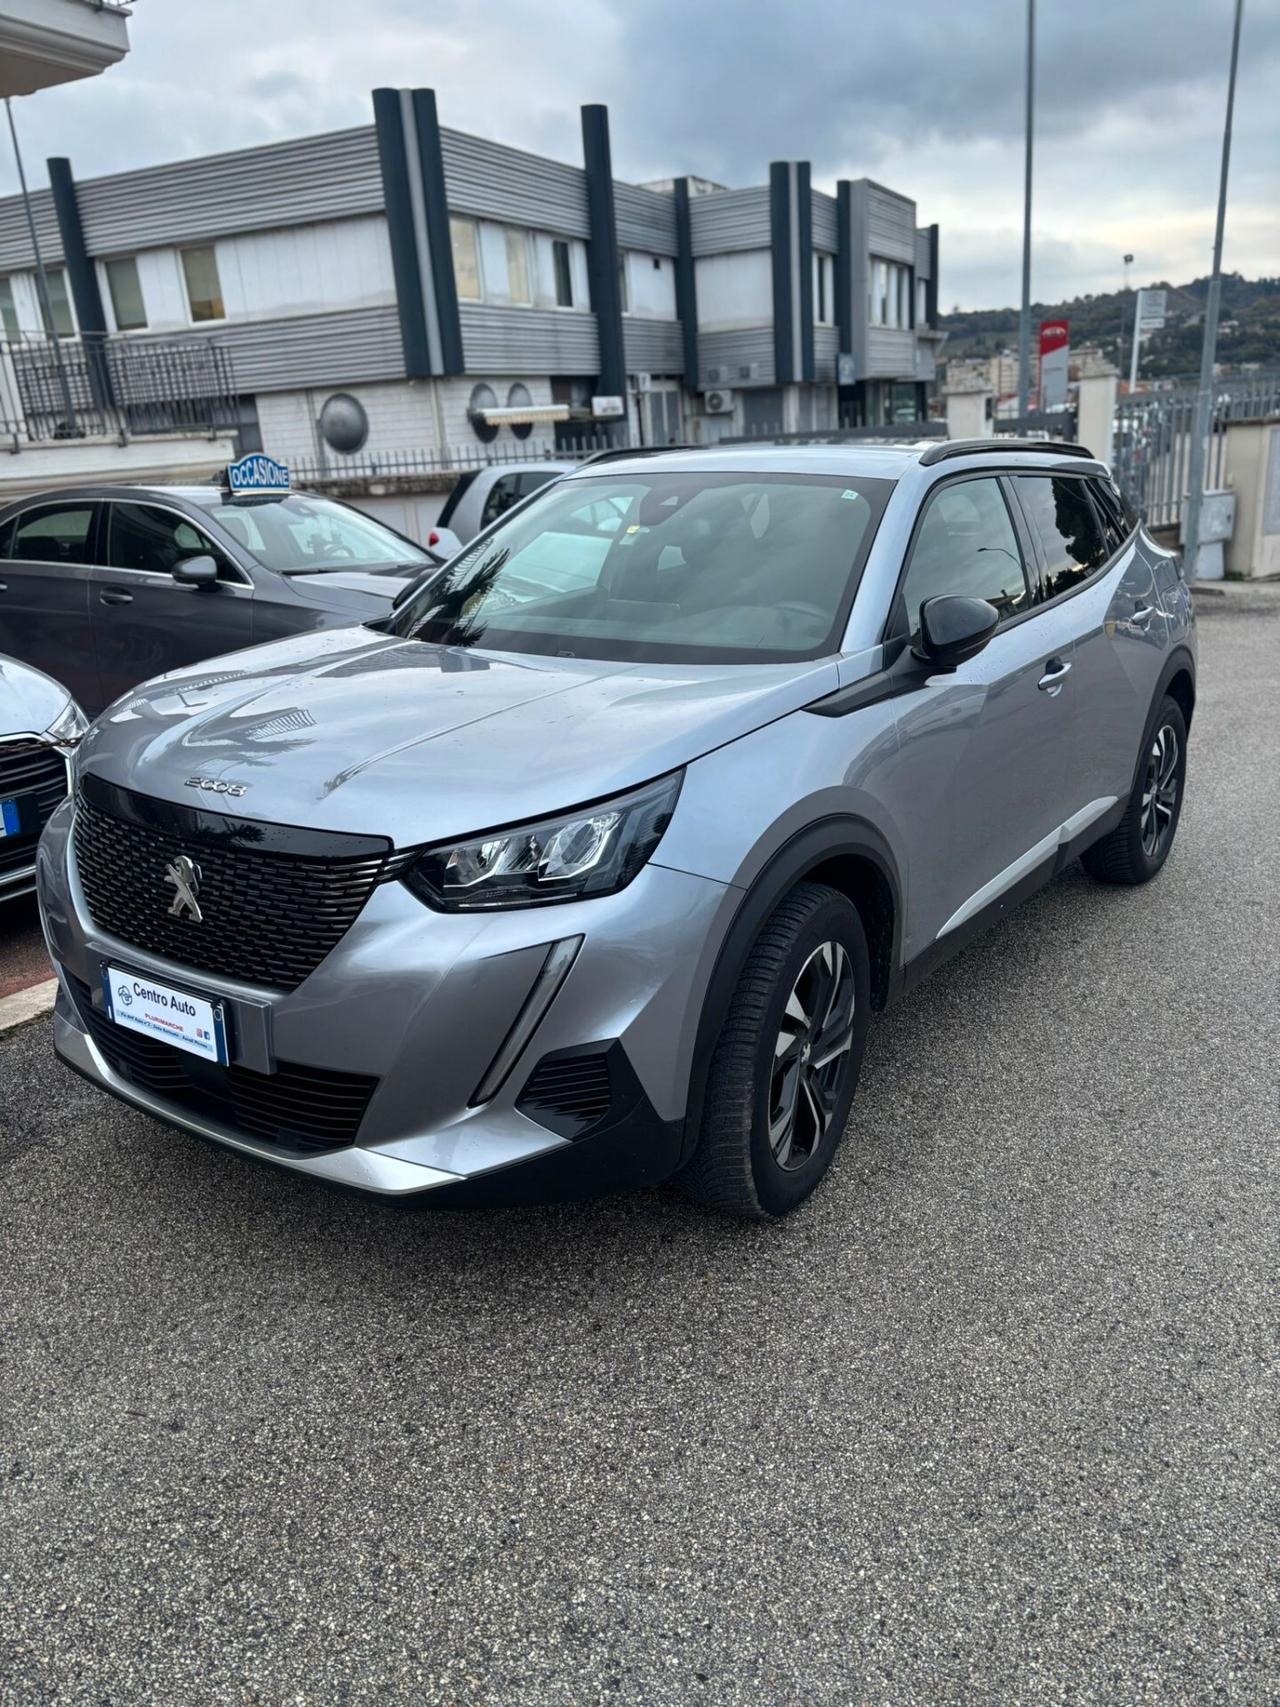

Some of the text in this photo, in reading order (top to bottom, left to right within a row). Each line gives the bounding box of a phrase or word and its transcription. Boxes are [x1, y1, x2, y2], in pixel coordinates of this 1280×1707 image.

[232, 458, 289, 486] OCCASIONE
[184, 776, 248, 797] 2008
[133, 982, 168, 1007] Centro
[170, 995, 196, 1017] Auto
[144, 1013, 184, 1032] PLURIMARCHE
